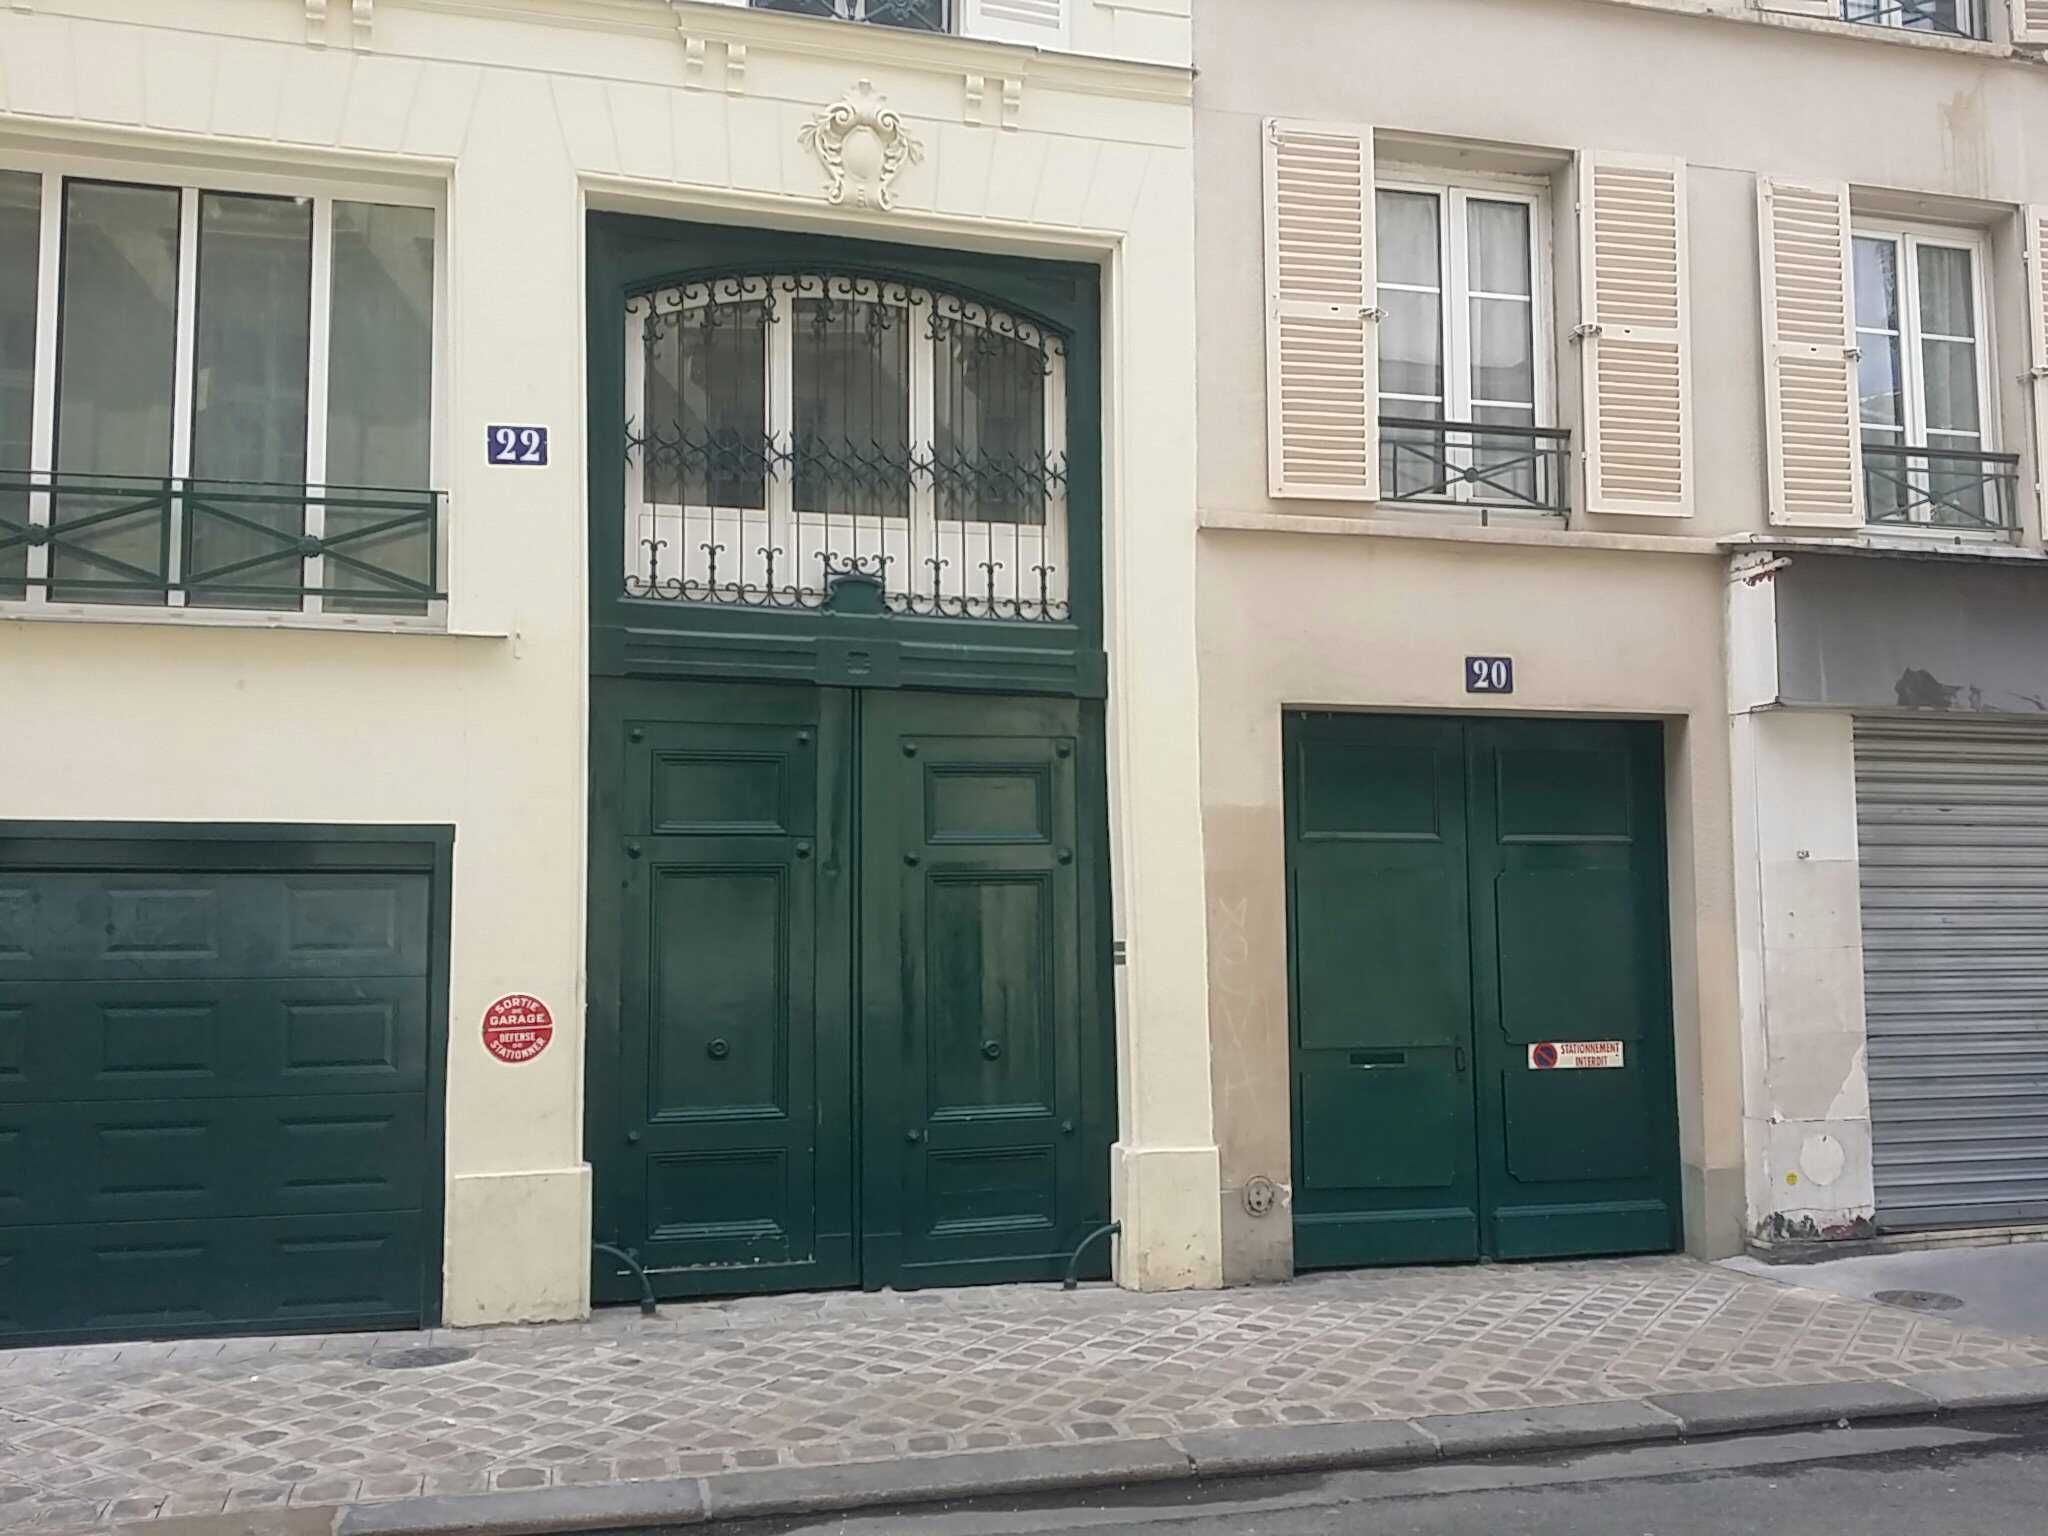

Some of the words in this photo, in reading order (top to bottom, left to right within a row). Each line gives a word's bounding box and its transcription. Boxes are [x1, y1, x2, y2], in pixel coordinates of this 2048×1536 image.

[496, 428, 540, 461] 22
[1473, 660, 1507, 689] 20
[495, 998, 541, 1014] SORTIE
[489, 1013, 545, 1026] GARAGE
[490, 1037, 546, 1060] STATIONNER
[1560, 1042, 1620, 1055] STATIONNEMENT
[1575, 1055, 1608, 1067] INTERDIT
